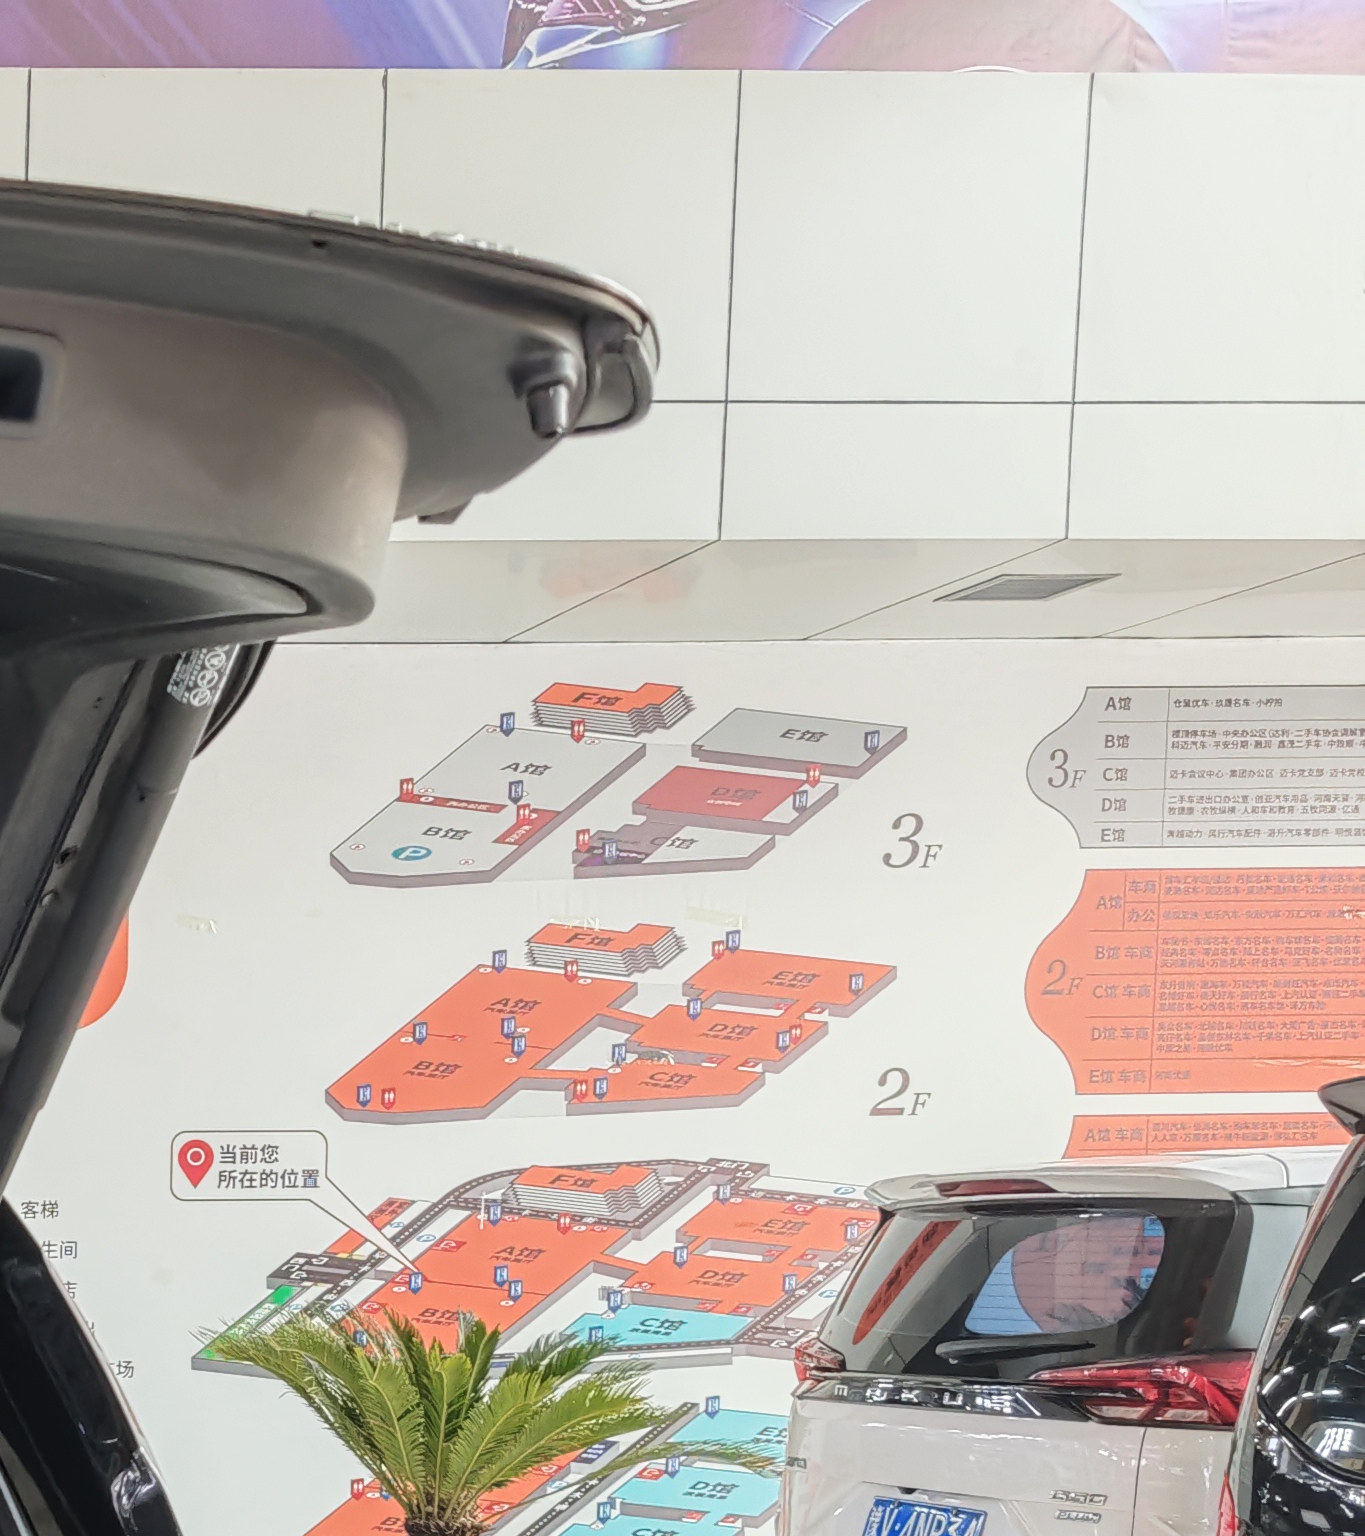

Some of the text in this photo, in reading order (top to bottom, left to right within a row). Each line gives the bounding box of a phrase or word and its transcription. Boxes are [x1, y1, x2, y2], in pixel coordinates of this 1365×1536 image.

[1104, 696, 1132, 711] A馆
[779, 728, 828, 743] E馆
[1104, 734, 1130, 749] B馆
[500, 762, 552, 776] A馆
[1047, 748, 1087, 789] 3F
[1102, 767, 1128, 782] C馆
[1101, 798, 1127, 813] D馆
[422, 826, 472, 841] B馆
[882, 813, 943, 869] 3F
[1100, 828, 1126, 843] E馆
[1128, 878, 1157, 895] 车商
[1096, 895, 1123, 911] A馆
[1127, 908, 1156, 923] 办公
[565, 932, 614, 947] F馆
[1094, 945, 1120, 960] B馆
[1124, 945, 1154, 960] 车商
[771, 971, 820, 985] E馆
[1041, 959, 1084, 997] 2F
[1092, 984, 1118, 999] C馆
[1122, 984, 1151, 999] 车商
[490, 997, 542, 1011] A馆
[707, 1023, 757, 1038] D馆
[1091, 1026, 1117, 1041] D馆
[1119, 1026, 1149, 1041] 车商
[411, 1060, 462, 1075] B馆
[649, 1071, 696, 1086] C馆
[1089, 1069, 1114, 1084] E馆
[1117, 1068, 1147, 1084] 车商
[868, 1066, 932, 1117] 2F
[1084, 1128, 1111, 1143] A馆
[1115, 1127, 1144, 1142] 车商
[218, 1144, 280, 1165] 当前您
[217, 1169, 321, 1190] 所在的位置
[548, 1174, 598, 1188] F馆
[20, 1200, 59, 1219] 客梯
[762, 1218, 811, 1232] E馆
[41, 1240, 78, 1259] 生间
[494, 1246, 546, 1260] A馆
[697, 1269, 749, 1284] D馆
[639, 1317, 688, 1331] C馆
[688, 1481, 739, 1496] D馆
